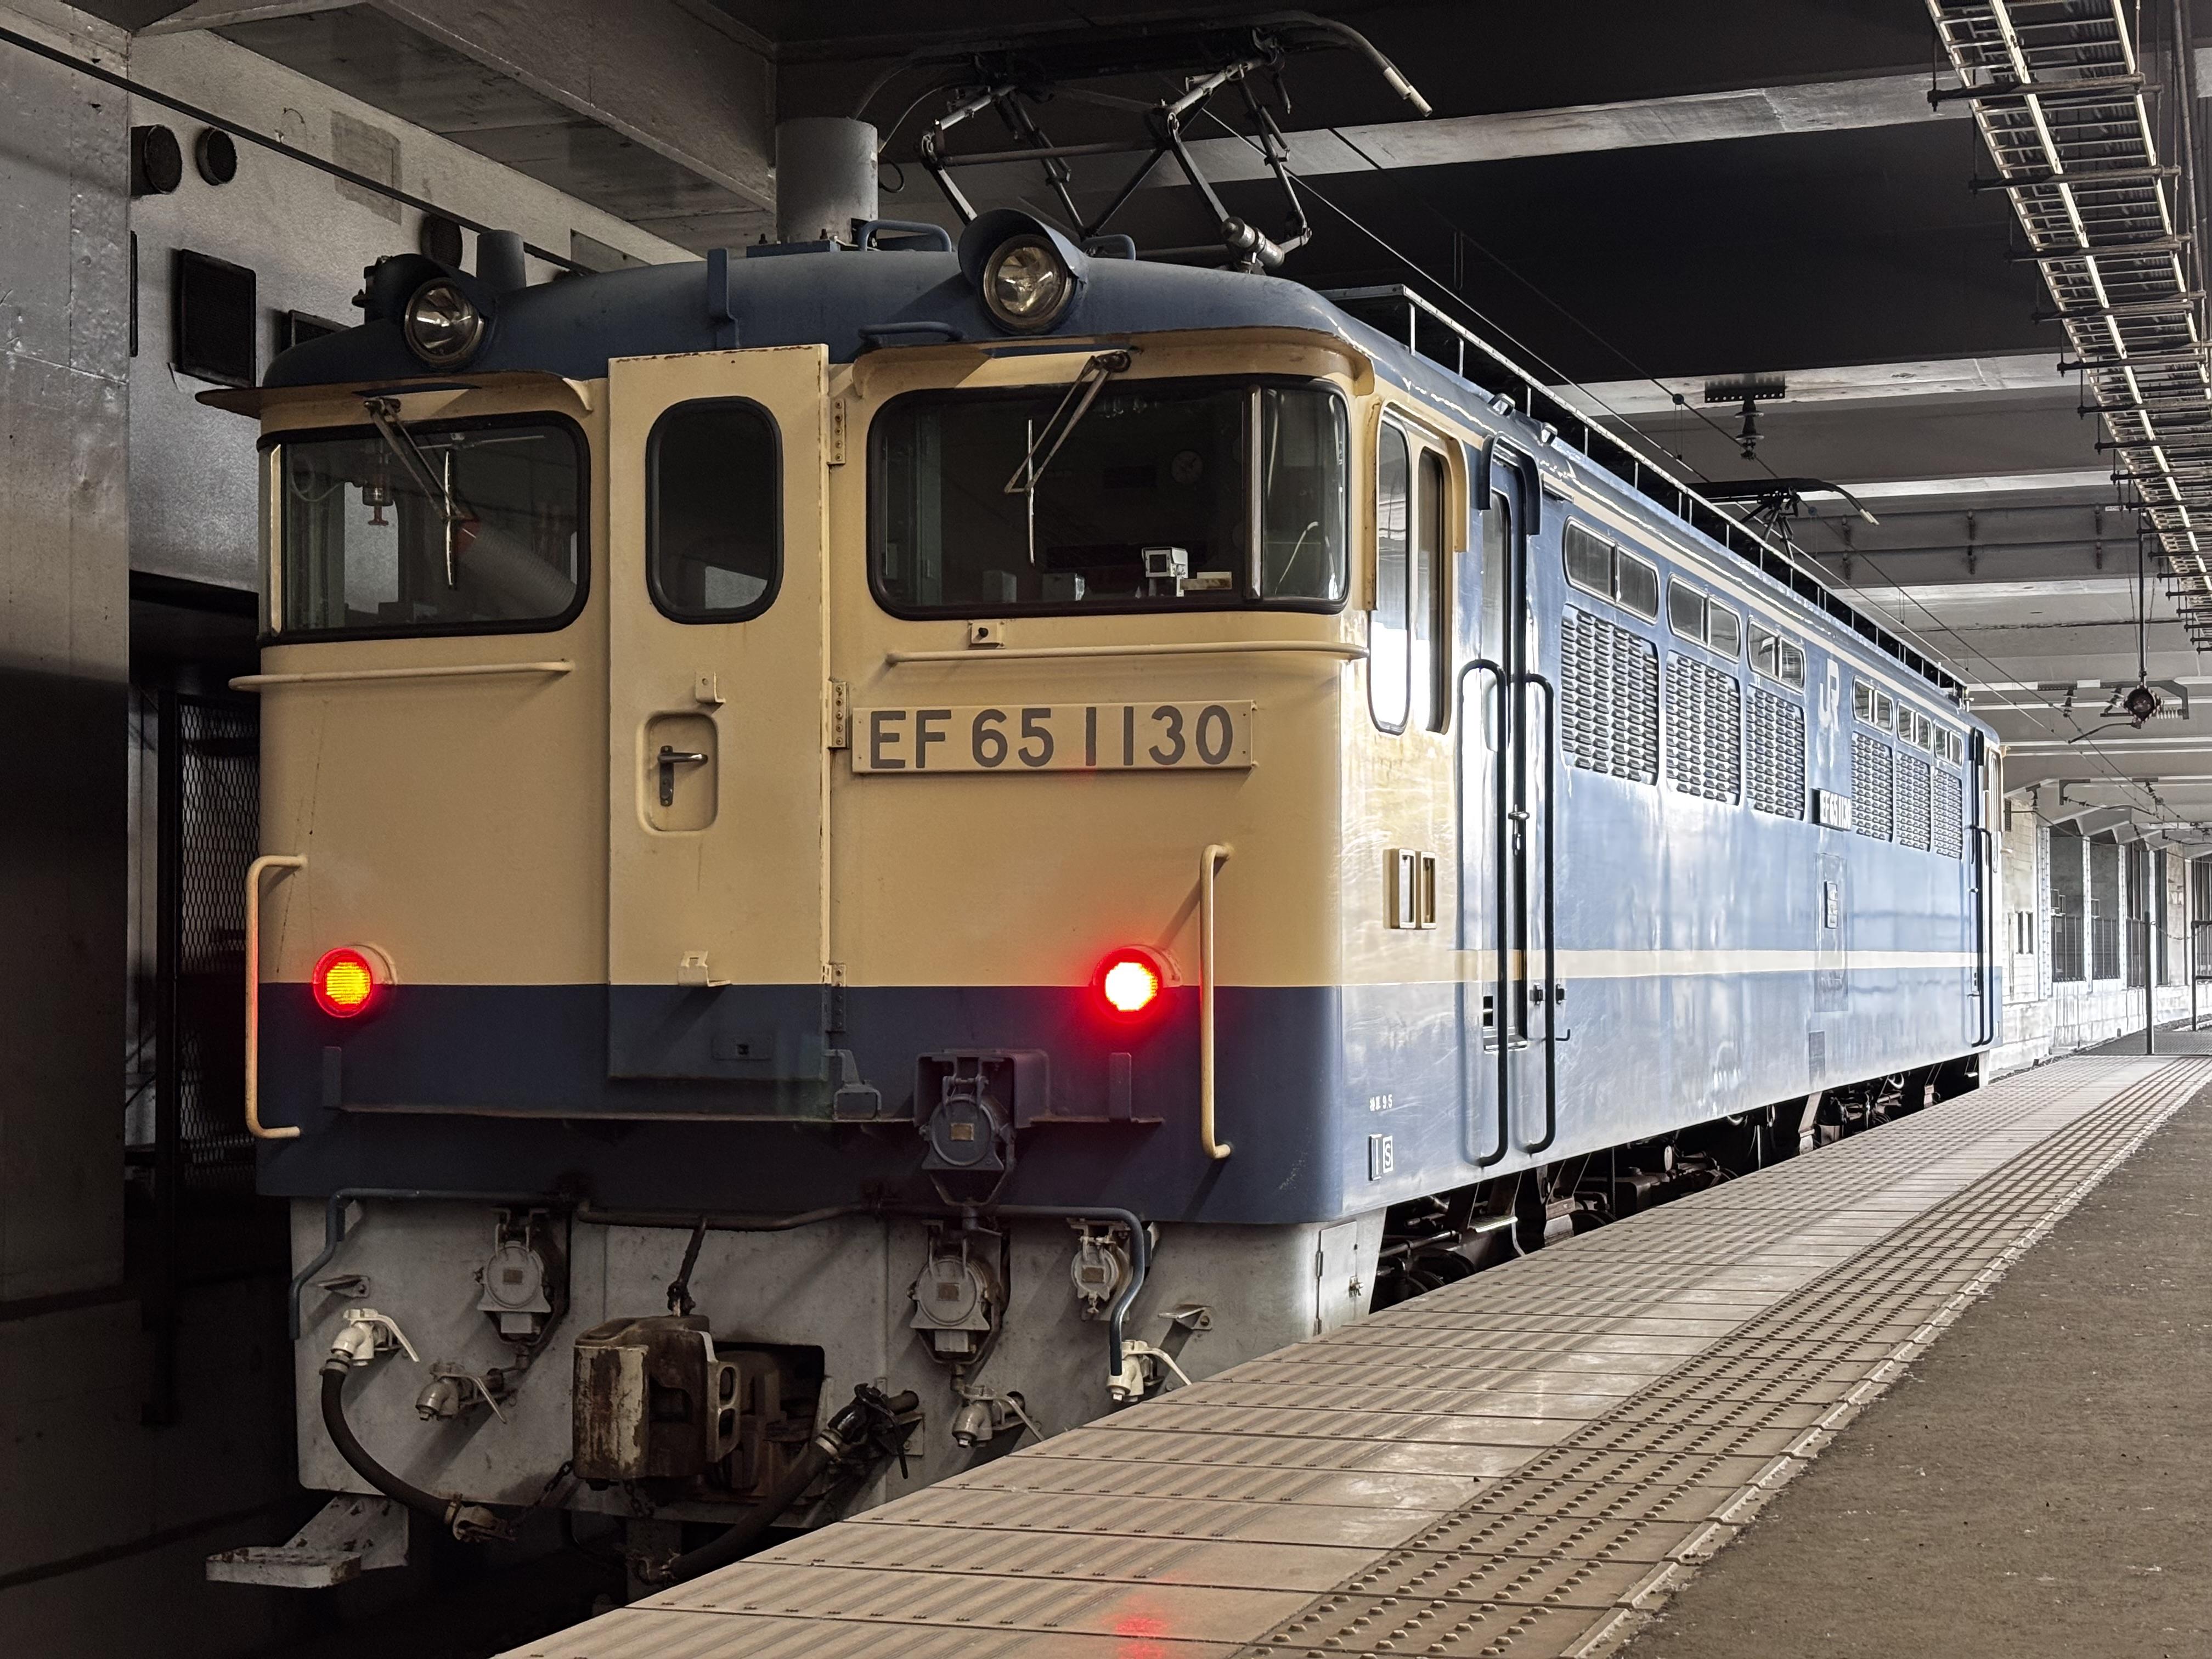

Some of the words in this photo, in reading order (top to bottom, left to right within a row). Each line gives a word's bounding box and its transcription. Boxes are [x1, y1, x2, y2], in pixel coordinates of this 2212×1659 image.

[1818, 658, 1839, 732] JR
[1085, 704, 1234, 766] 1130
[1385, 1143, 1391, 1166] S
